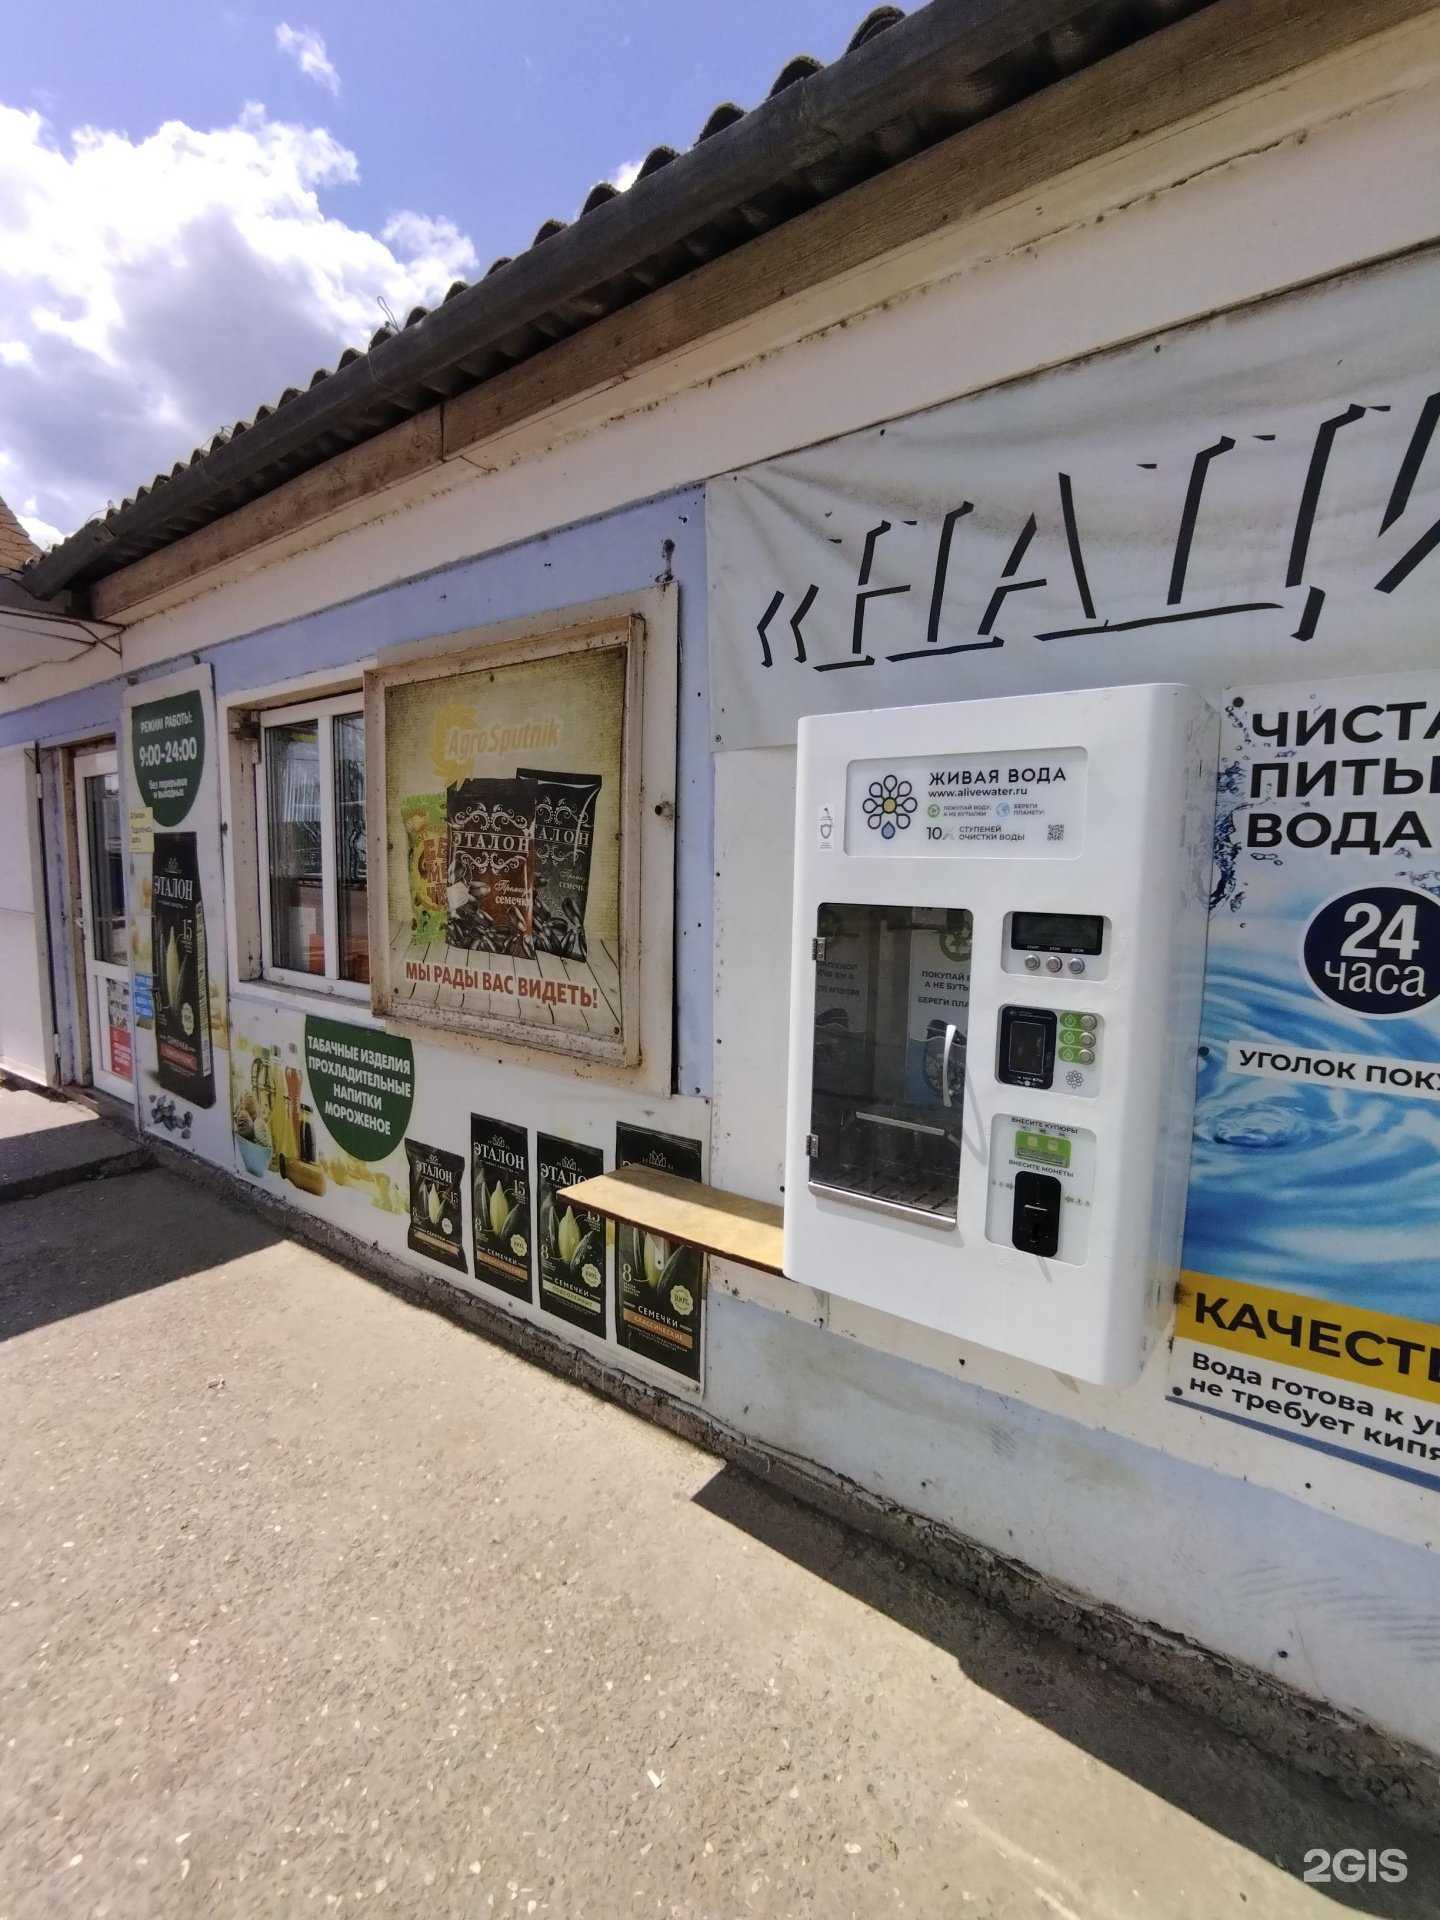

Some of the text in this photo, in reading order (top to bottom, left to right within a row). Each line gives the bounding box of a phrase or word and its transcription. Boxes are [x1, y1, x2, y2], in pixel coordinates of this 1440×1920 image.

[140, 712, 193, 734] РЕЖИМ РАБОТЫ:
[139, 737, 197, 767] 9:00-24:00
[929, 767, 1066, 785] ЖИВАЯ ВОДА
[928, 787, 1028, 798] www.alivewater.ru
[959, 824, 1002, 833] СТУПЕНЕЙ
[1246, 810, 1433, 856] ВОДА
[453, 832, 529, 852] ЭТАЛОН
[154, 876, 193, 900] ЭТАЛОН
[1340, 901, 1420, 961] 24
[406, 962, 598, 1009] МЫ РАДЫ ВАС ВИДЕТЬ!
[1324, 960, 1426, 999] часа
[307, 1035, 411, 1075] ТАБАЧНЫЕ ИЗДЕЛИЯ
[1239, 1049, 1356, 1080] УГОЛОК
[308, 1056, 411, 1098] ПРОХЛАДИТЕЛЬНЫЕ
[333, 1083, 382, 1111] НАПИТКИ
[325, 1101, 391, 1135] МОРОЖЕНОЕ
[1011, 1116, 1043, 1127] ВНЕСИТЕ
[1044, 1123, 1078, 1135] КУПЮРЫ
[473, 1142, 525, 1170] ЭТАЛОН
[416, 1160, 452, 1183] ЭТАЛОН
[540, 1163, 588, 1184] ЭТАЛО
[1008, 1159, 1074, 1178] ВНЕСИТЕ МОНЕТЫ
[514, 1179, 525, 1196] 15
[622, 1263, 632, 1282] 8
[554, 1278, 589, 1297] СЕМЕЧКИ
[638, 1305, 678, 1328] СЕМЕЧКИ
[1192, 1351, 1262, 1386] Вода
[1272, 1376, 1374, 1417] готова
[1385, 1407, 1404, 1425] к
[1189, 1377, 1440, 1461] не требует кипя
